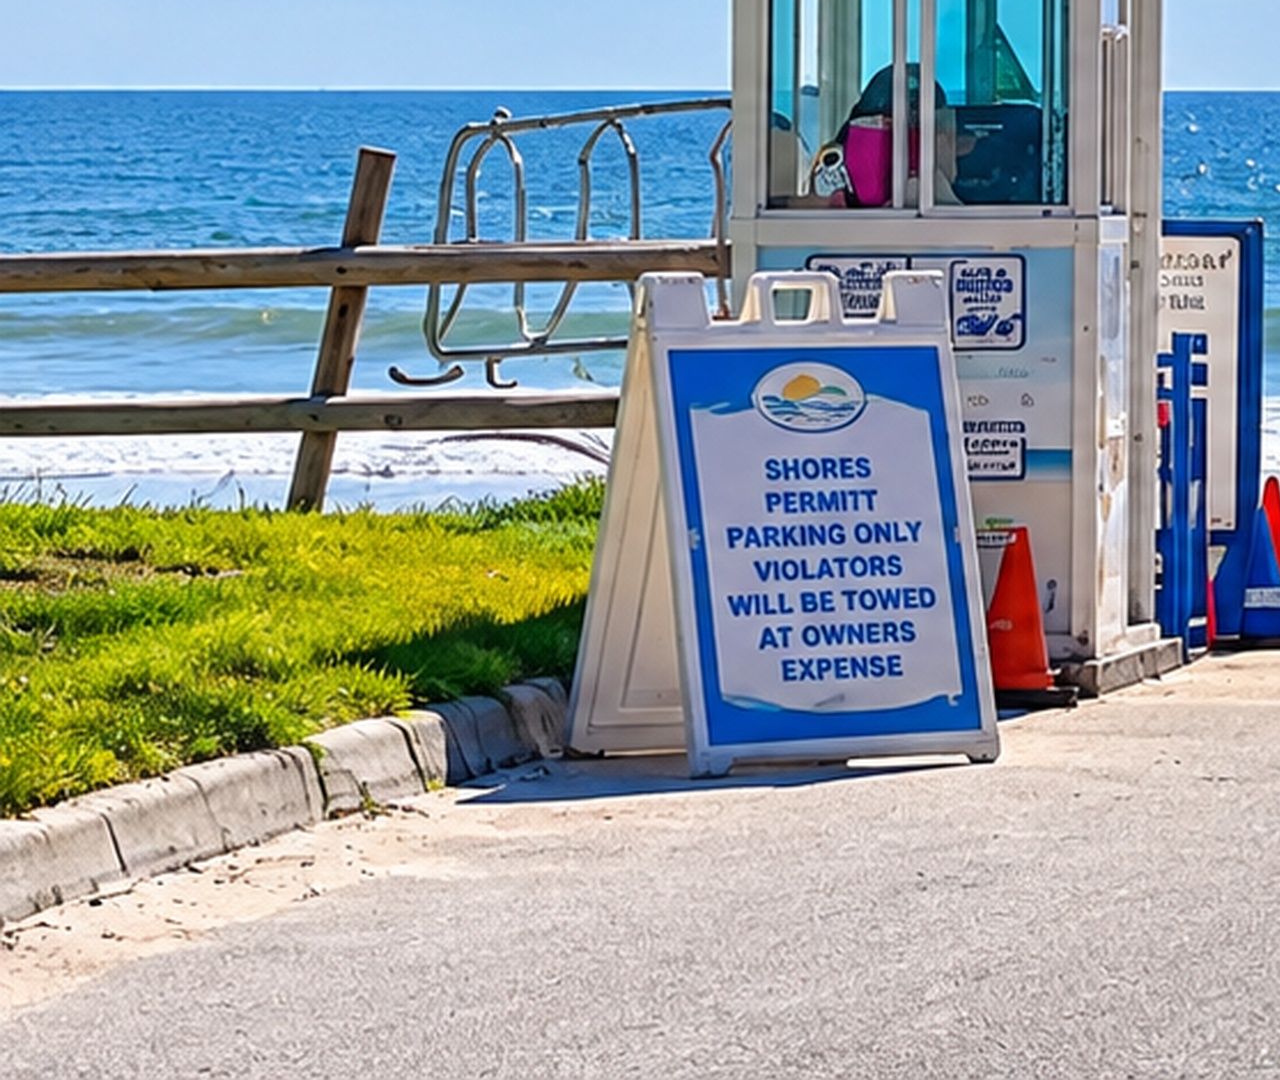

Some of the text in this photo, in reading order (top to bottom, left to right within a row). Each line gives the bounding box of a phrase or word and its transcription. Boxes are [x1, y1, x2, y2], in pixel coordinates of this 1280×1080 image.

[764, 456, 872, 481] SHORES
[764, 489, 878, 514] PERMITT
[726, 520, 922, 549] PARKING ONLY
[752, 554, 903, 583] VIOLATORS
[727, 586, 937, 617] WILL BE TOWED
[758, 620, 917, 651] AT OWNERS
[780, 654, 904, 682] EXPENSE
